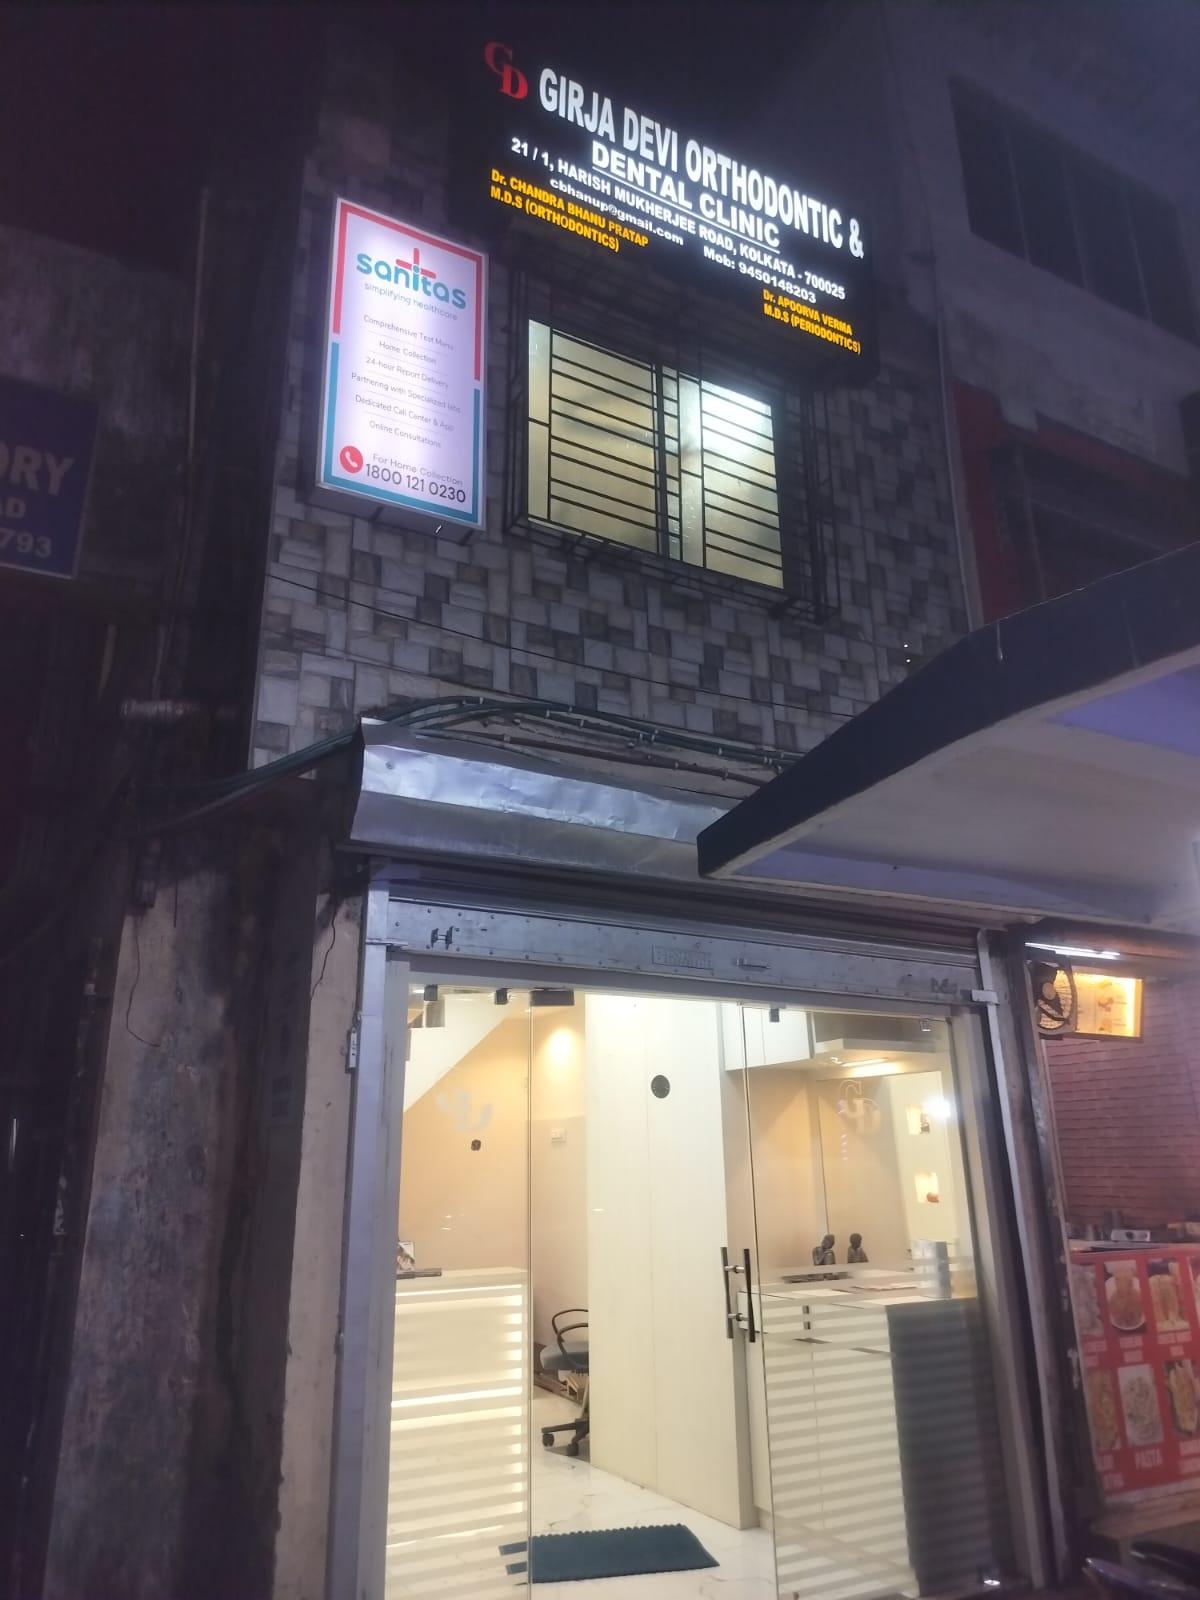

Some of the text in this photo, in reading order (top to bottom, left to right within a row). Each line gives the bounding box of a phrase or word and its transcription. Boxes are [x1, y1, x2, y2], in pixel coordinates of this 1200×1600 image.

[539, 68, 864, 258] GIRJA DEVI ORTHODONTIC &
[491, 168, 649, 247] Dr. CHANDRA BHANU PRATAP
[550, 178, 683, 246] cbhanup@gmail.com
[592, 140, 780, 248] DENTAL CLINIC
[490, 185, 619, 252] M.D.S (ORTHODONTICS)
[511, 137, 528, 157] 21
[541, 152, 554, 172] 1,
[558, 158, 611, 196] HARISH
[615, 186, 696, 235] MUKHERJEE
[699, 224, 737, 256] ROAD,
[740, 243, 796, 279] KOLKATA
[805, 271, 845, 300] 700025
[356, 252, 466, 310] sanitas
[703, 246, 816, 303] Mob: 9450148203
[364, 283, 458, 321] simplifying healthcare
[763, 288, 852, 336] Dr. APOORVA VERMA
[363, 314, 418, 338] Comprehensive
[419, 332, 434, 343] Test
[379, 340, 437, 364] Home Collection
[763, 303, 860, 355] M.D.S (PERIODONTICS)
[351, 372, 389, 391] Partnering
[390, 385, 406, 394] with
[397, 365, 421, 379] Report
[421, 373, 449, 389] Delivery
[355, 394, 392, 412] Dedicated
[393, 405, 407, 417] Call
[409, 411, 431, 423] Center
[369, 420, 441, 448] Online Consultations
[366, 463, 466, 503] 1800 121 0230
[373, 453, 463, 486] For Home Collection
